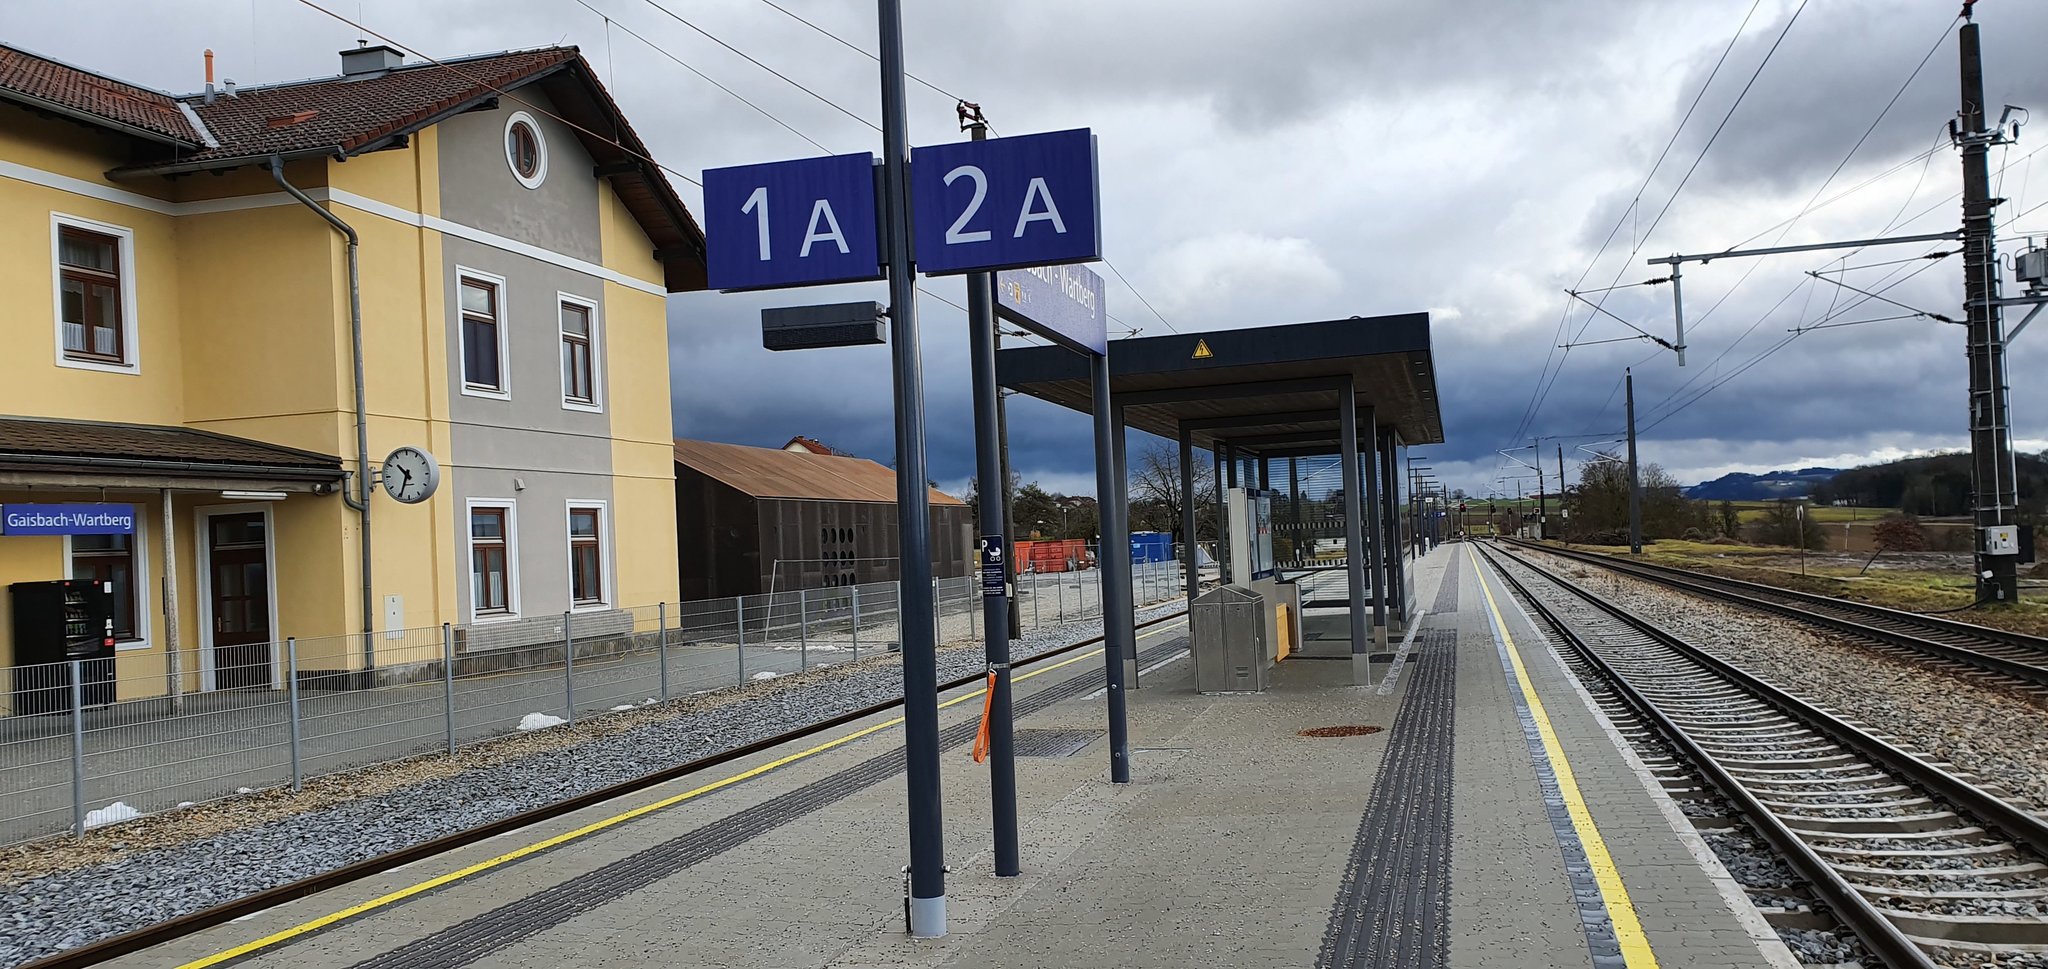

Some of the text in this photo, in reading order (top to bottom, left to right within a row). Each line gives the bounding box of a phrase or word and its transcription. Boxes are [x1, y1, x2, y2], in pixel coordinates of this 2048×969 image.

[740, 187, 850, 261] 1 A
[942, 165, 1067, 245] 2 A
[1060, 265, 1095, 319] Wartberg
[7, 512, 131, 530] Gaisbach-Wartberg
[982, 539, 988, 552] P
